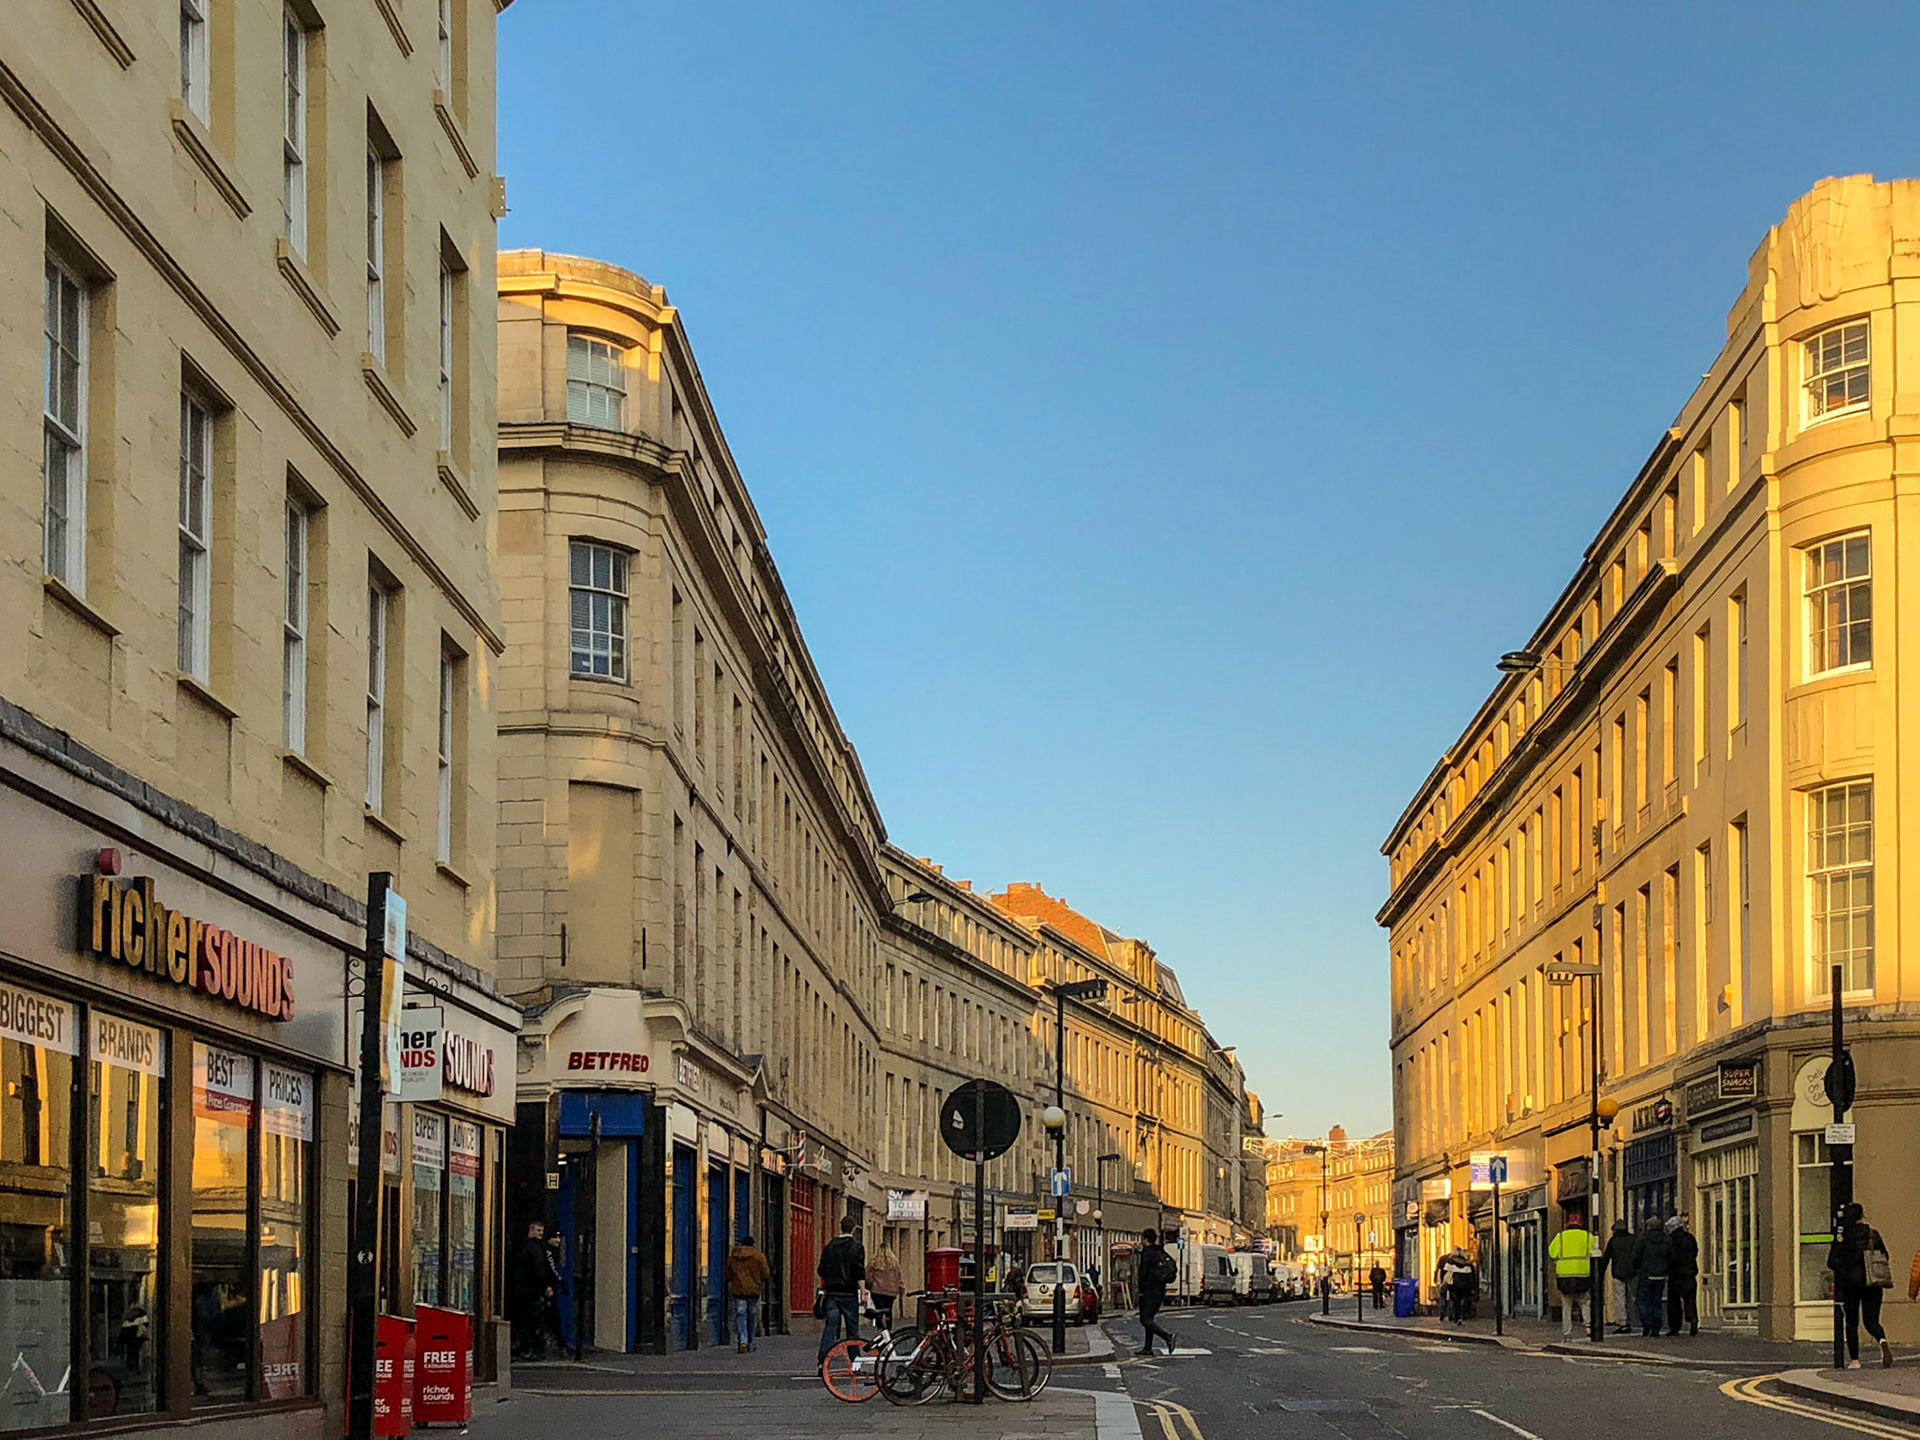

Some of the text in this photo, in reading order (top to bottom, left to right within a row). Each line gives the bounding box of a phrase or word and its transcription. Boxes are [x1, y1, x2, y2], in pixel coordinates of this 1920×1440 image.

[82, 848, 295, 1022] richer SOUNDS
[0, 989, 64, 1042] BIGGEST
[98, 1019, 153, 1066] BRANDS
[207, 1052, 235, 1088] BEST
[444, 1030, 495, 1097] SOUNDS
[568, 1051, 649, 1073] BETFRED
[1721, 1077, 1754, 1088] SNACKS
[1724, 1069, 1751, 1079] SUPER
[1807, 1069, 1823, 1083] Deli
[269, 1069, 302, 1106] PRICES
[414, 1112, 439, 1141] EXPERT
[893, 1201, 922, 1210] TO LET
[422, 1350, 456, 1364] FREE
[375, 1360, 393, 1373] EE
[422, 1393, 455, 1402] sounds
[423, 1385, 451, 1394] richer
